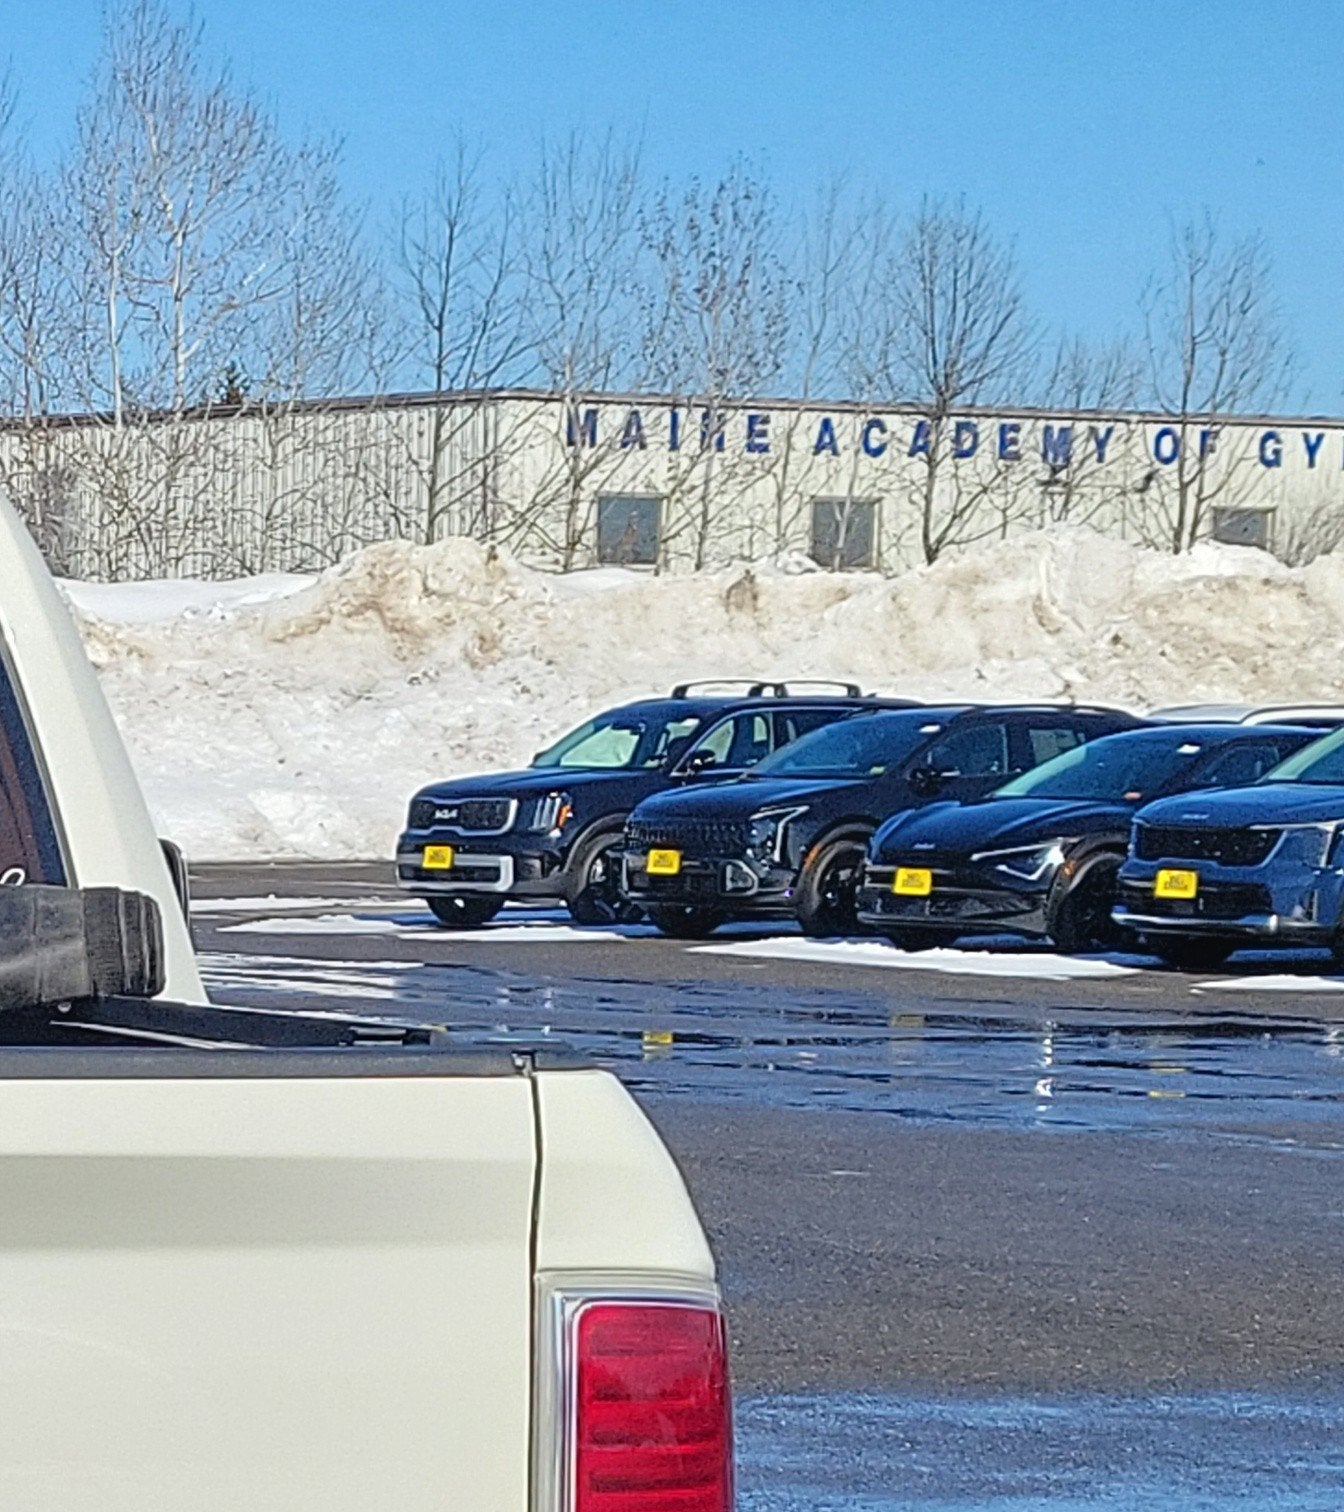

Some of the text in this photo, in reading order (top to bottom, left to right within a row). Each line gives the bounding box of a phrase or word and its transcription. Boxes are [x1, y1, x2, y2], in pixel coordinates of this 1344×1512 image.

[812, 416, 1114, 466] ACADEMY
[1154, 427, 1218, 466] OF
[1258, 430, 1344, 471] GY
